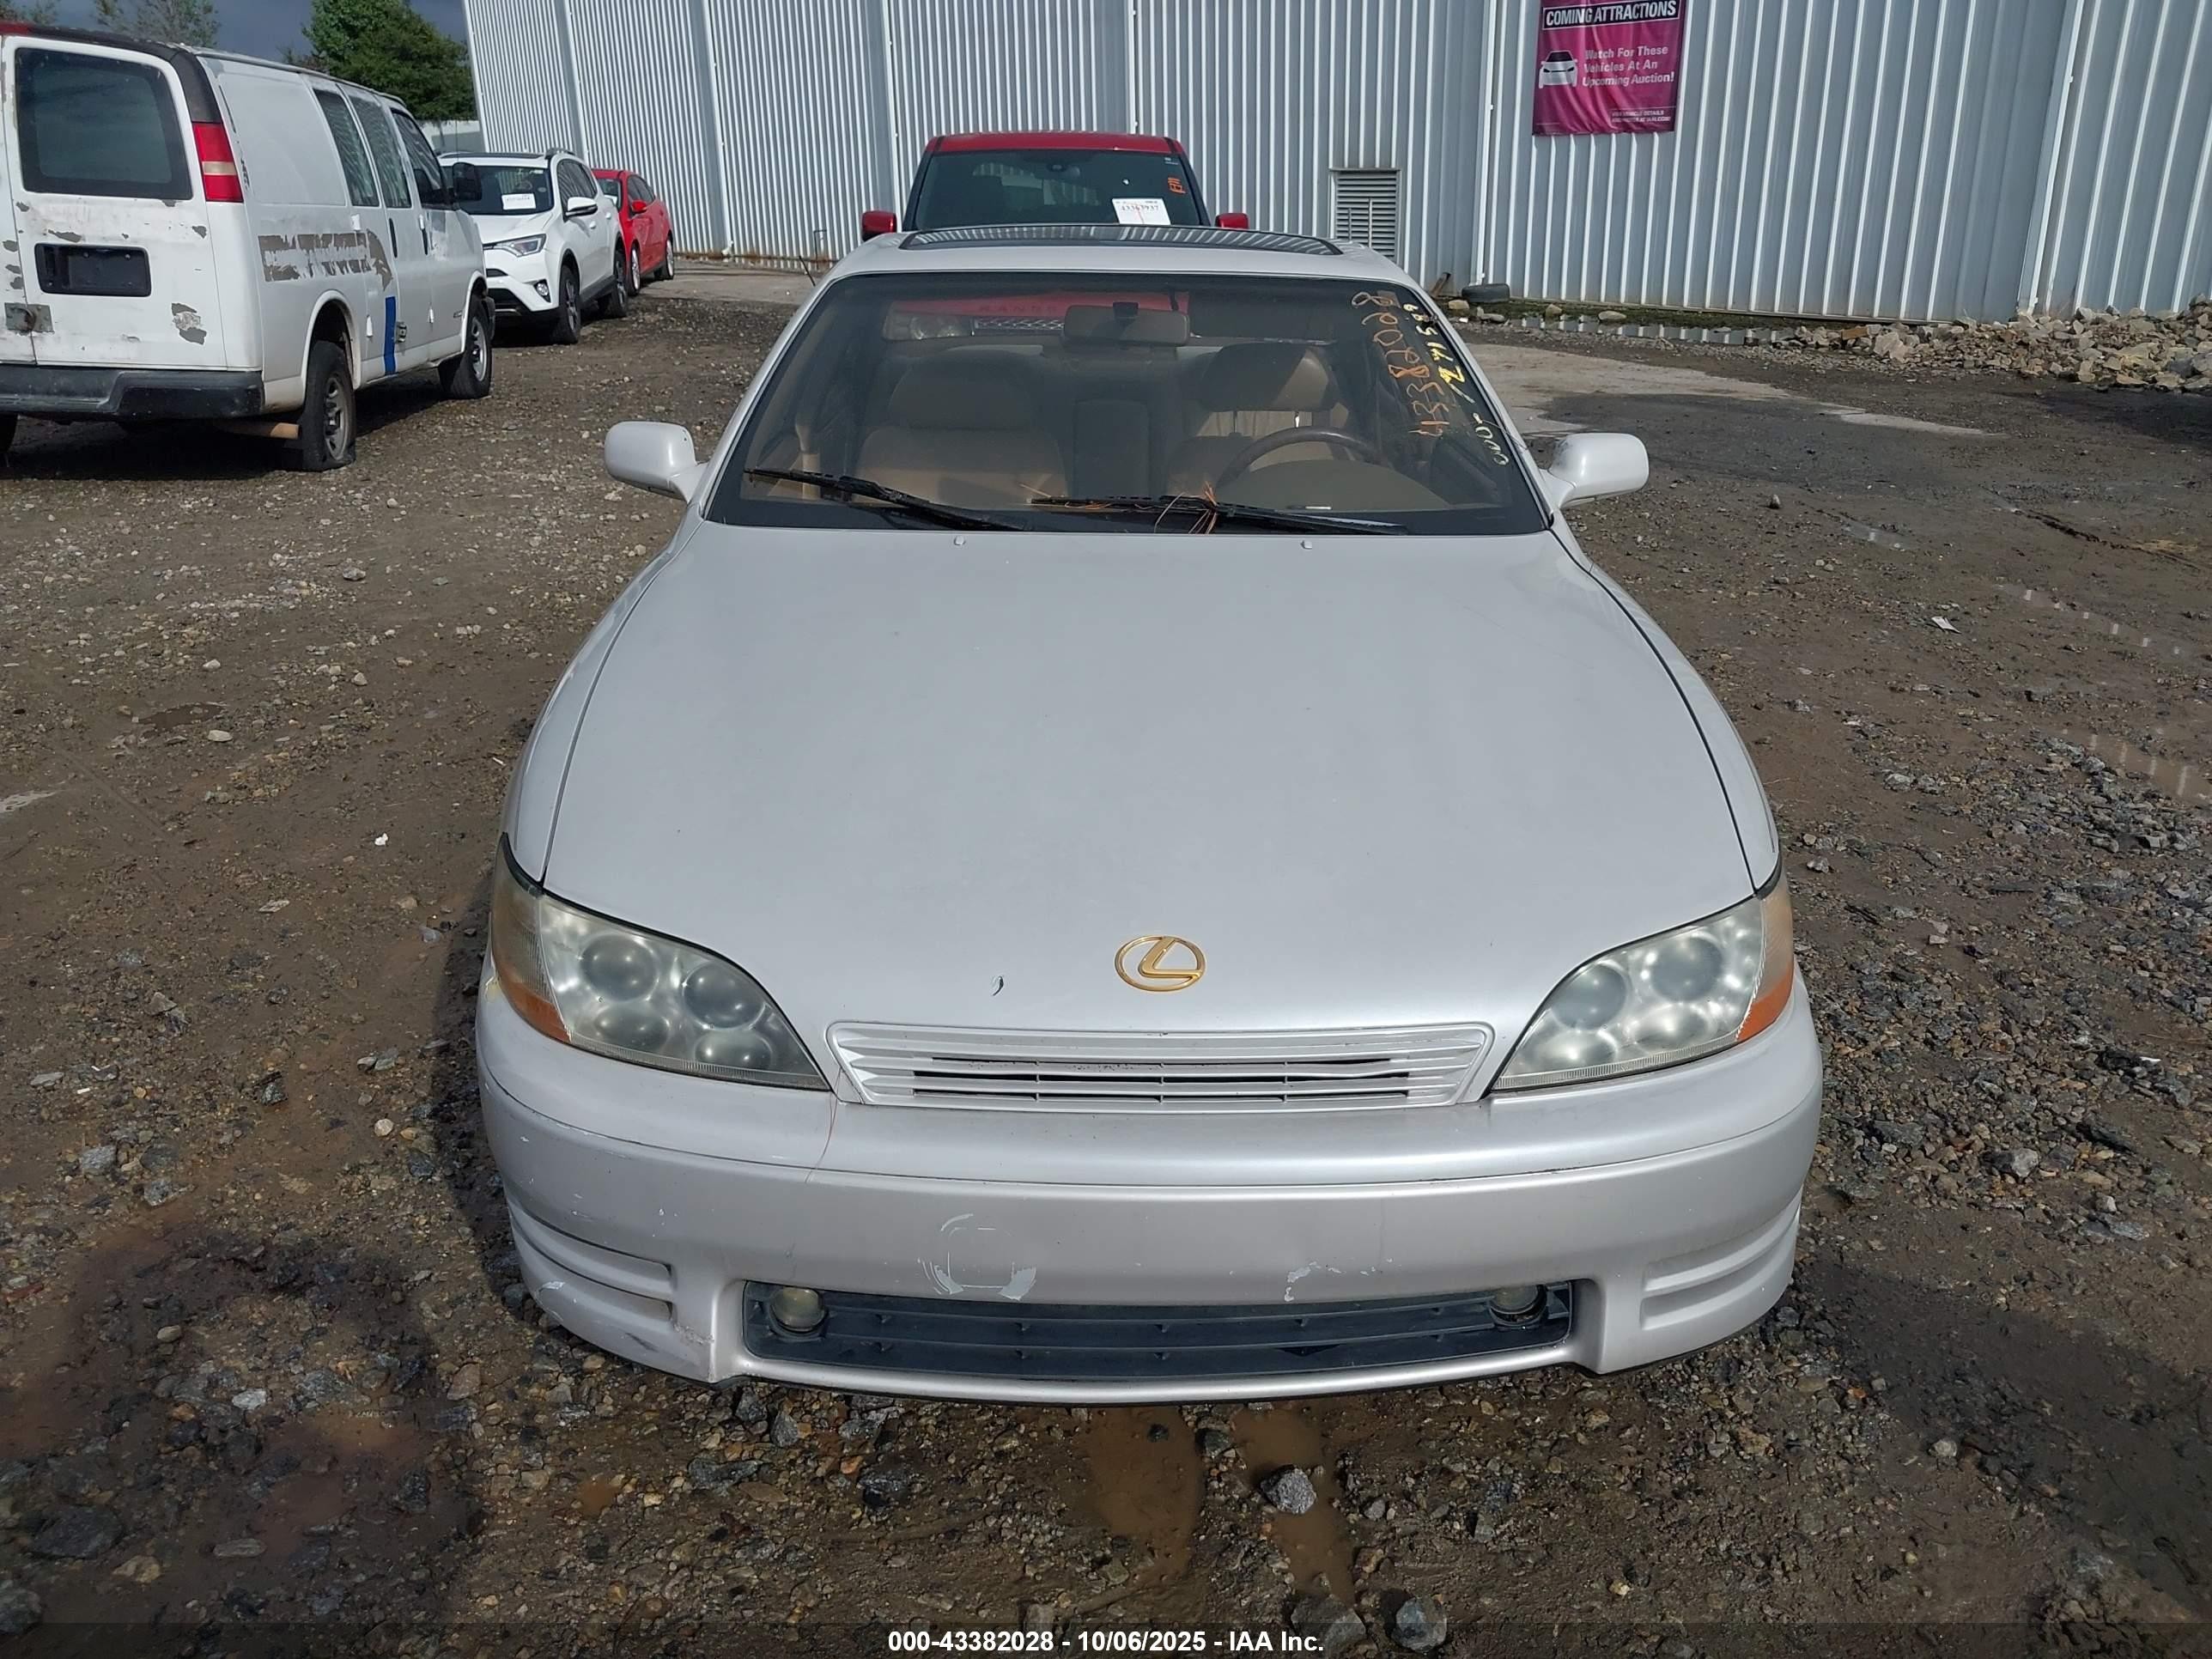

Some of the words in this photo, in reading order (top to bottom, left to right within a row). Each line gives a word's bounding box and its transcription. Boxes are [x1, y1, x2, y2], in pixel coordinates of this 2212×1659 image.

[1546, 8, 1592, 26] COMING
[1594, 1, 1677, 23] ATTRACTIONS
[1585, 48, 1614, 59] Watch
[1618, 47, 1634, 58] For
[1637, 46, 1668, 56] These
[1583, 62, 1624, 73] Vehicles
[1628, 61, 1640, 70] At
[1643, 59, 1658, 70] An
[1582, 76, 1630, 88] Upcoming
[1631, 71, 1674, 84] Auction!
